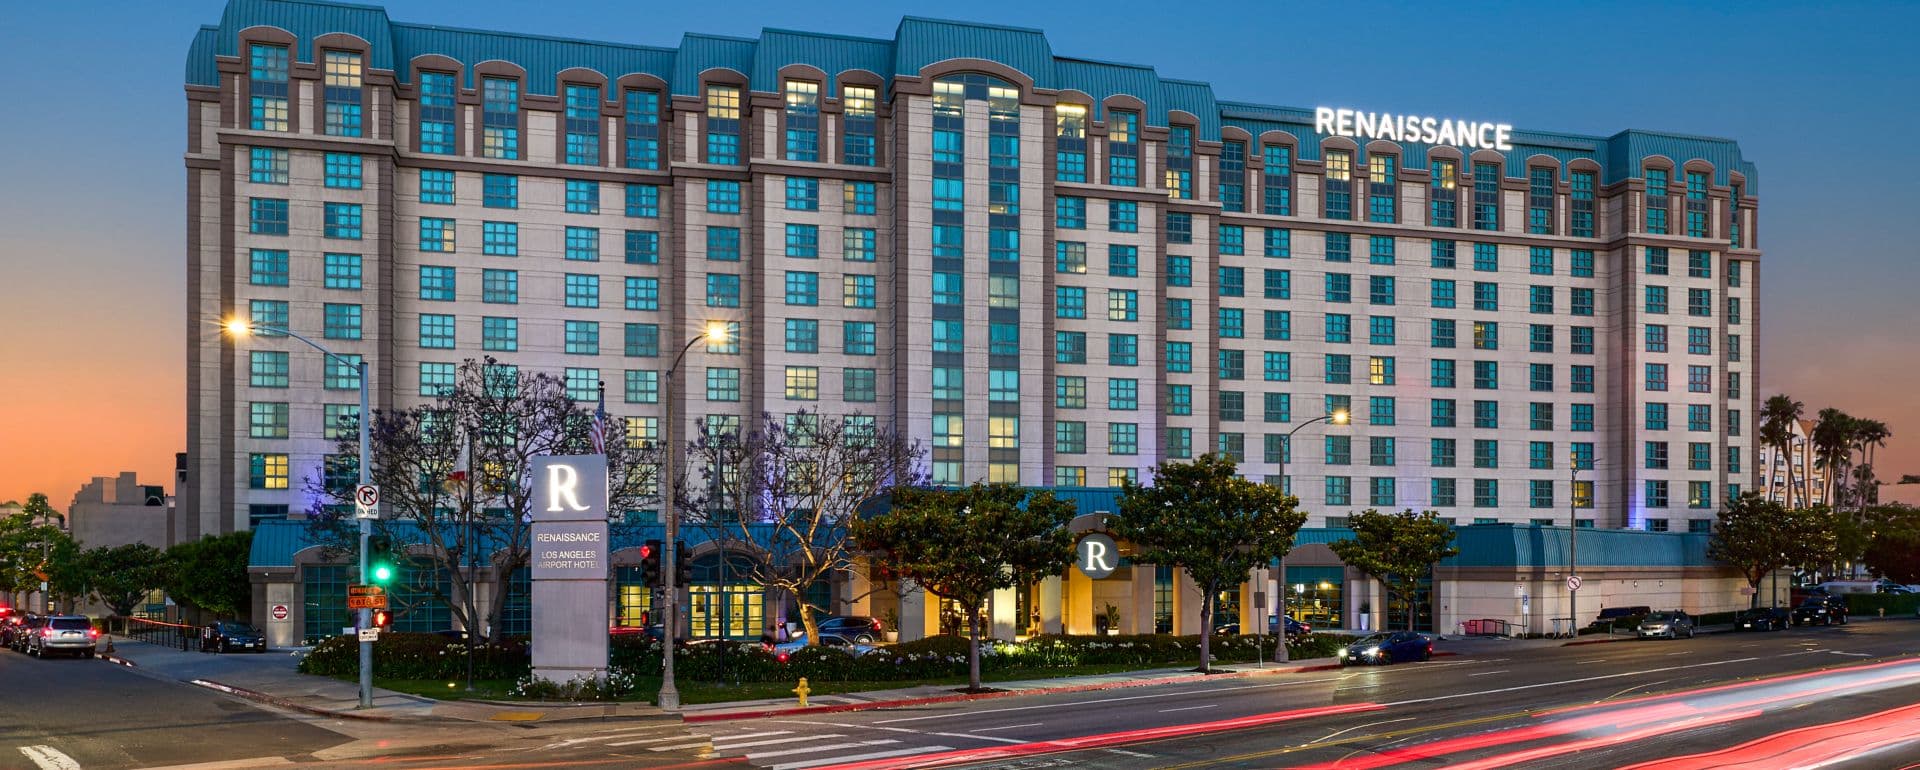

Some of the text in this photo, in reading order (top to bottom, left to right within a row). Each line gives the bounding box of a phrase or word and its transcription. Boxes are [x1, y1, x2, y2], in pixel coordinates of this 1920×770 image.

[1315, 106, 1513, 151] RENAISSANCE
[546, 464, 591, 512] R
[537, 532, 600, 542] RENAISSANCE
[538, 560, 601, 569] AIRPORT HOTEL
[541, 550, 597, 559] LOS ANGELES
[1085, 541, 1115, 571] R
